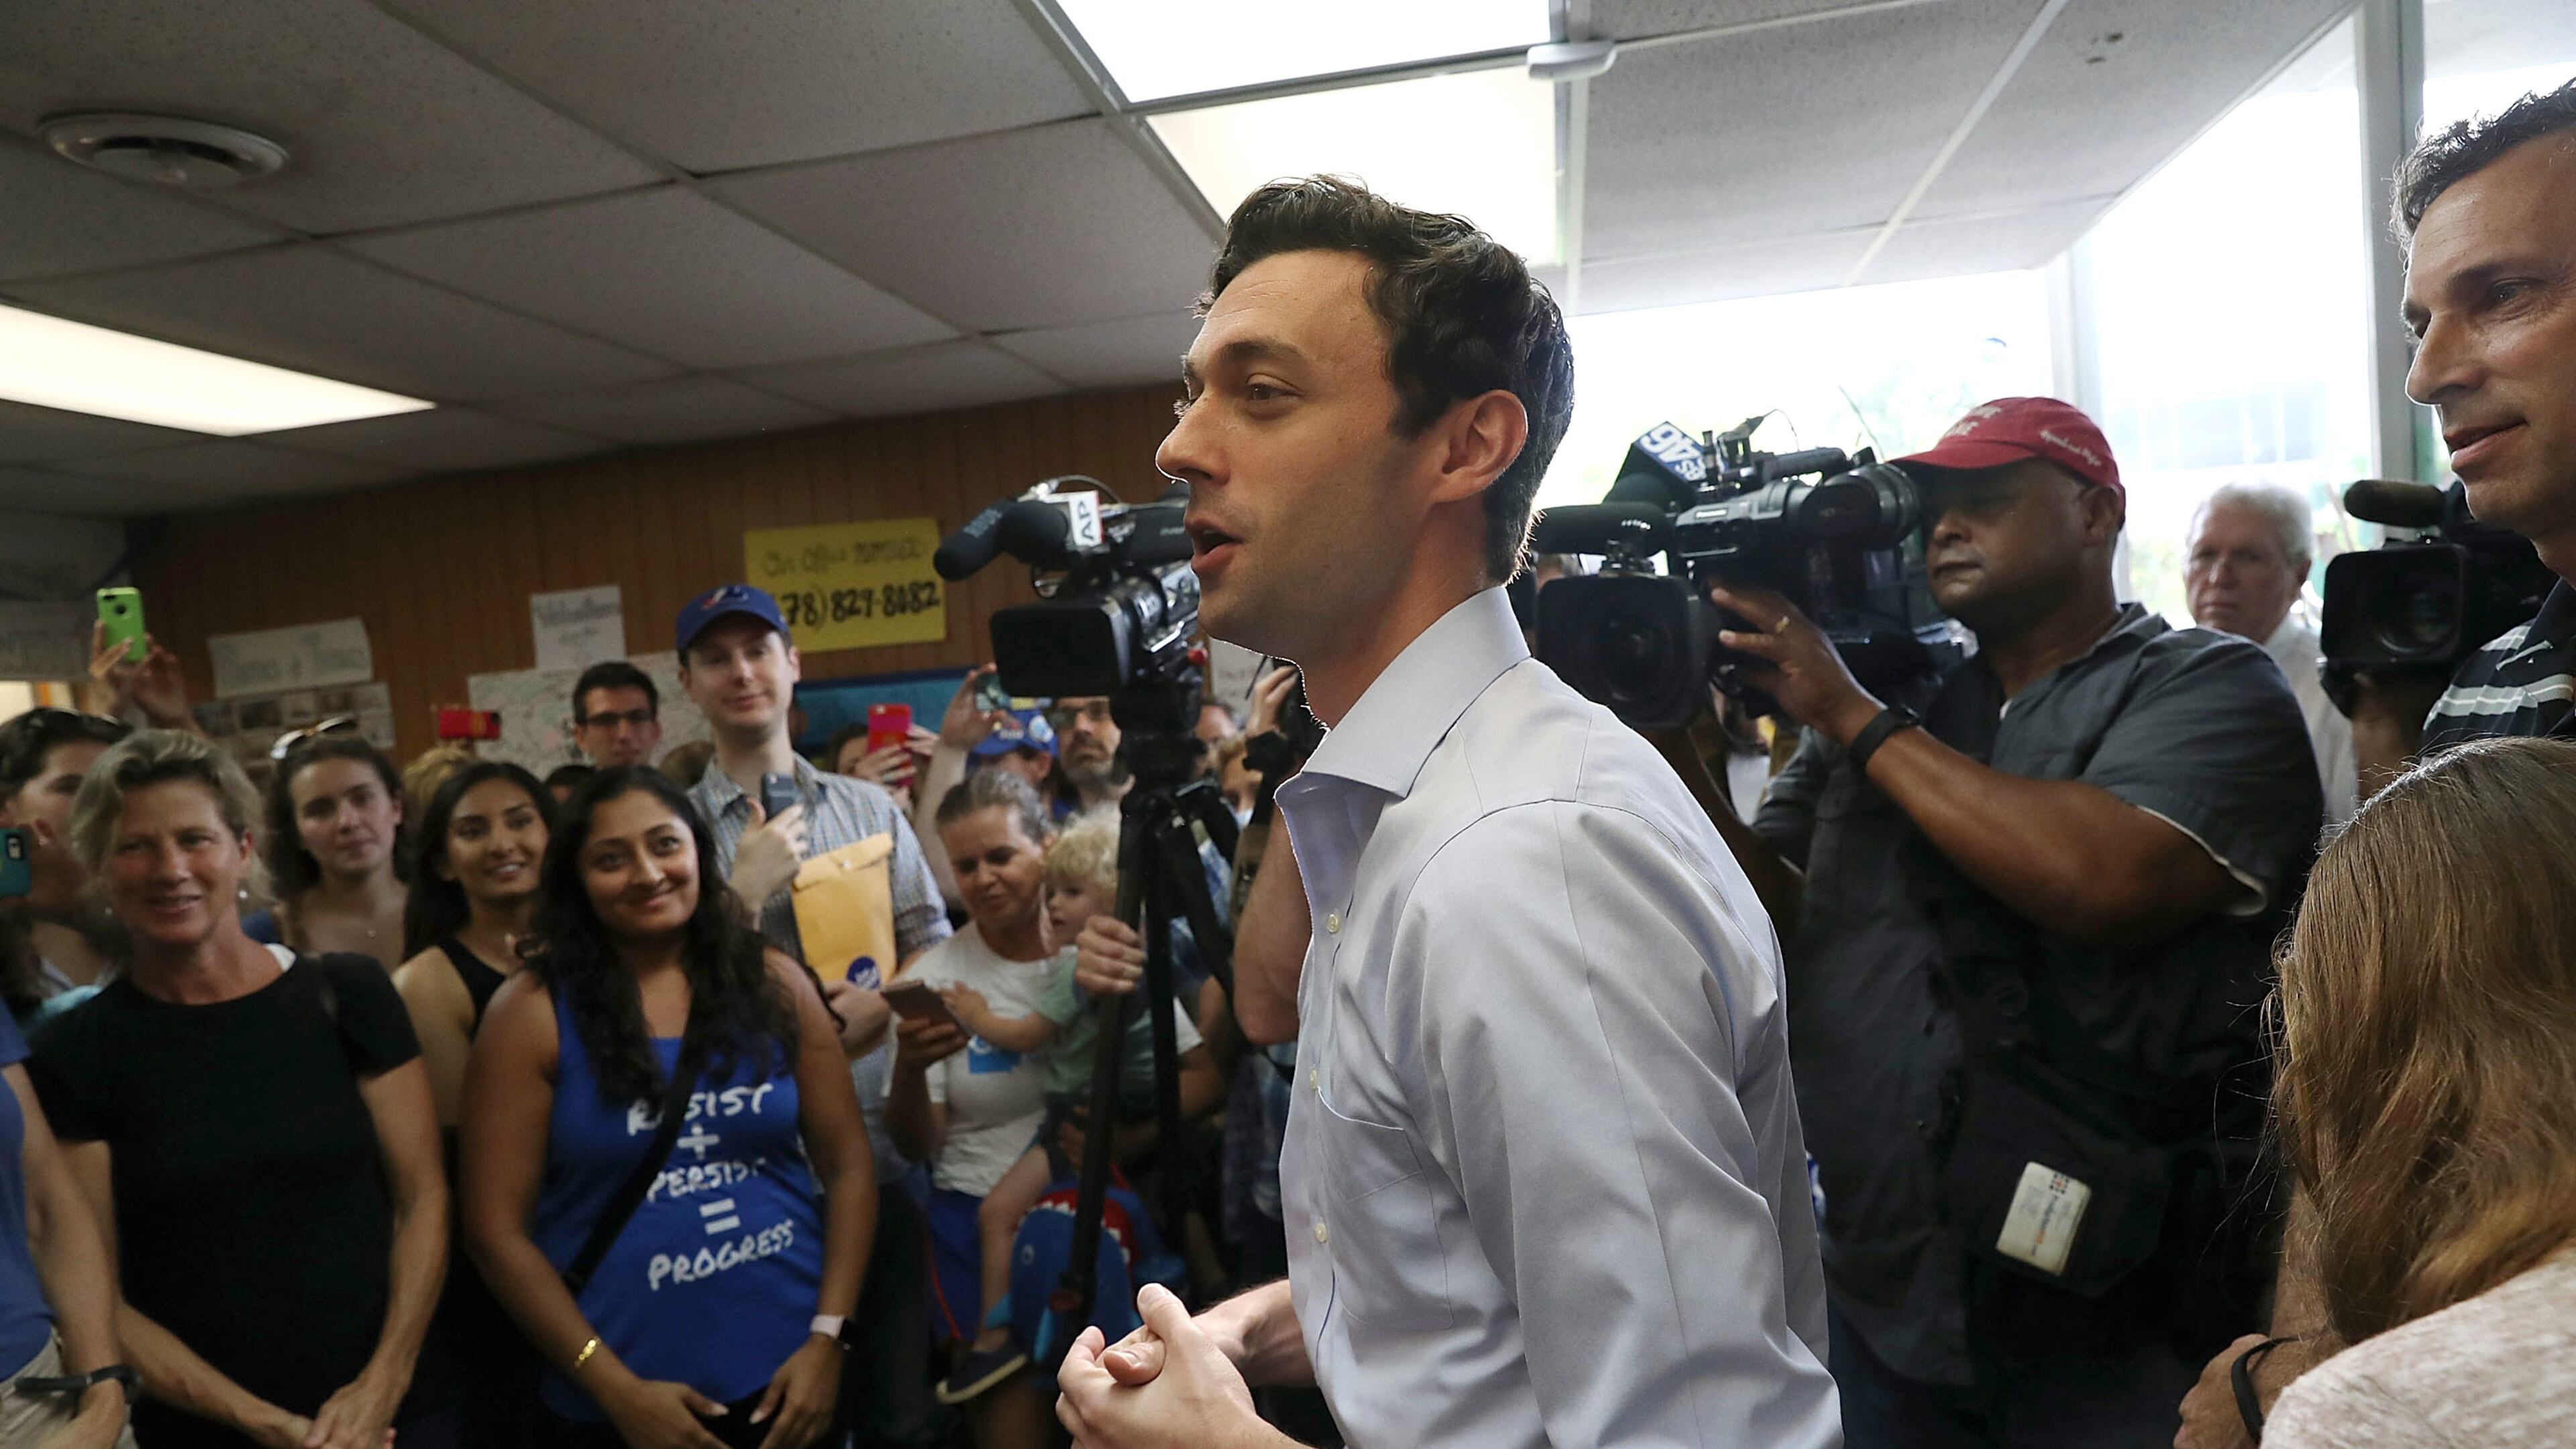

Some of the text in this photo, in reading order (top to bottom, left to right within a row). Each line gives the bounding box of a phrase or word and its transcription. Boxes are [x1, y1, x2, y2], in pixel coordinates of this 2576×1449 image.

[1078, 501, 1094, 539] AP
[627, 1083, 773, 1136] RSIST
[647, 1218, 794, 1291] PROGRESS
